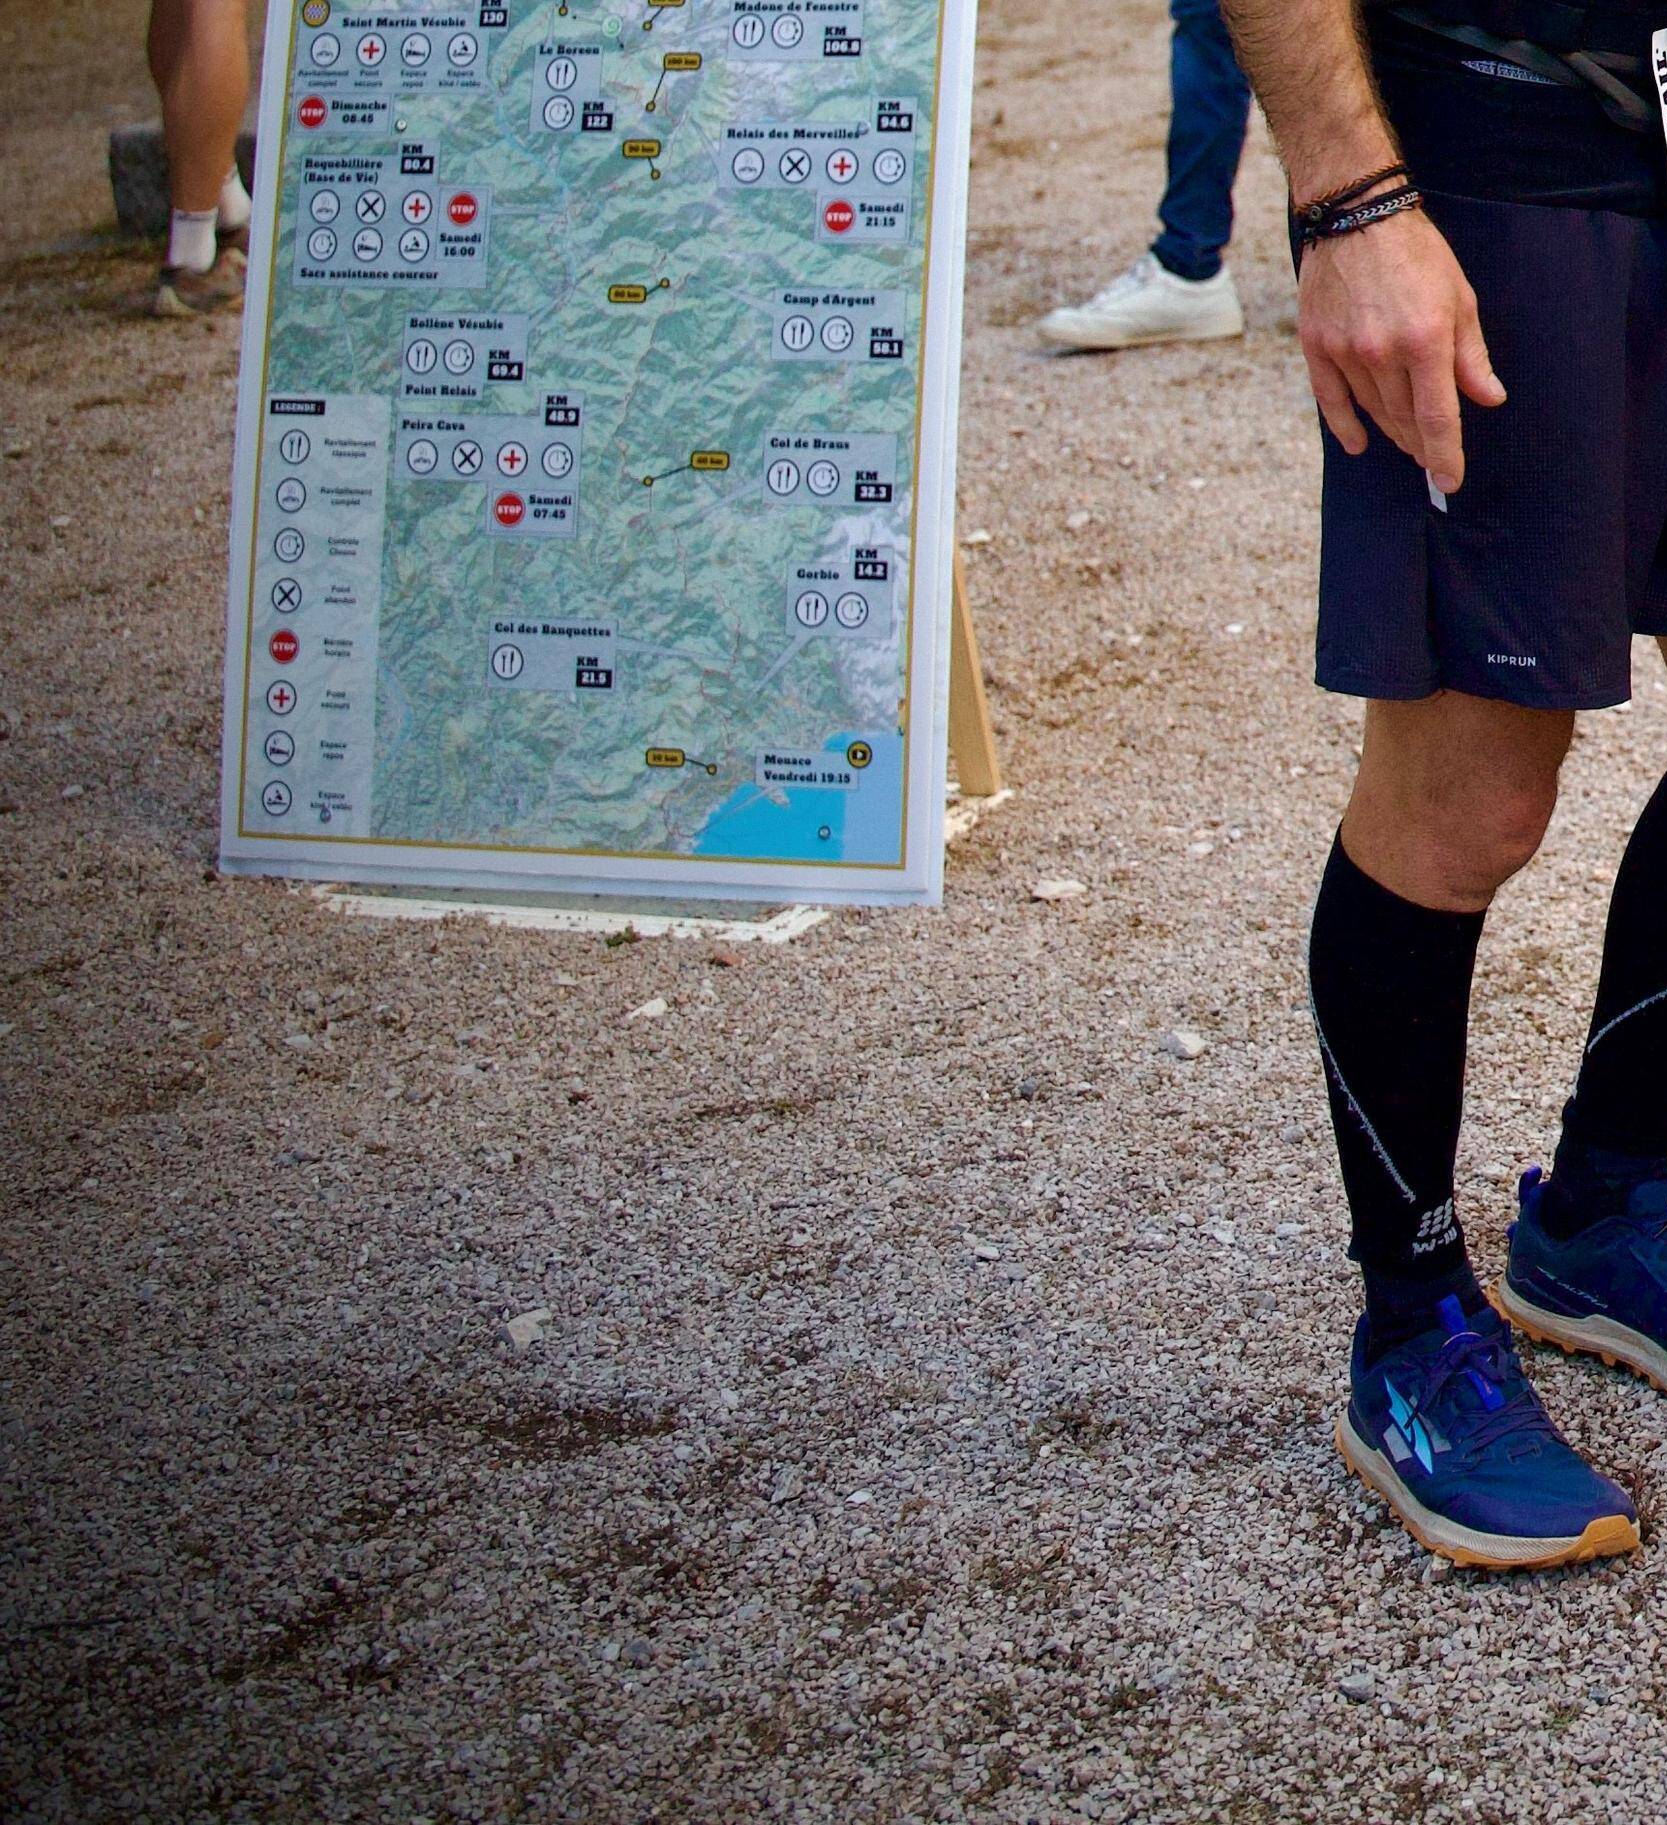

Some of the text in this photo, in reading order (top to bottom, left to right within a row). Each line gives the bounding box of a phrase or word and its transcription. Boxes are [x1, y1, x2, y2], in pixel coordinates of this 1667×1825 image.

[734, 1, 860, 12] Madone de Fenestre
[342, 17, 374, 27] Saint
[376, 17, 417, 27] Martin
[482, 11, 504, 24] 130
[825, 26, 847, 36] KM
[540, 45, 554, 55] Le
[331, 101, 388, 111] Dimanche
[583, 102, 605, 111] KM
[878, 101, 900, 111] KM
[300, 107, 325, 118] STOP
[586, 115, 609, 127] 122
[727, 128, 861, 140] Relais des Merveilles
[402, 144, 424, 154] KM
[338, 172, 352, 183] de
[355, 172, 379, 185] Vie)
[450, 203, 475, 214] STOP
[859, 202, 905, 213] Samedi
[824, 210, 853, 223] STOP
[440, 233, 482, 244] Samedi
[329, 268, 390, 280] assistance
[392, 270, 439, 280] coureur
[783, 293, 819, 307] Camp
[871, 327, 893, 337] KM
[488, 349, 510, 360] KM
[405, 384, 478, 397] Point Relais
[546, 395, 568, 405] KM
[437, 420, 466, 432] Cava
[770, 438, 850, 450] Col de Braus
[855, 470, 878, 481] KM
[528, 494, 573, 505] Samedi
[496, 504, 523, 515] STOP
[855, 548, 878, 559] KM
[796, 568, 840, 581] Gorbio
[494, 622, 612, 639] Col des Banquettes
[272, 641, 297, 652] STOP
[576, 656, 599, 667] KM
[1487, 653, 1537, 667] KIPRUN
[763, 754, 812, 766] Monaco
[763, 770, 818, 783] Vendredi
